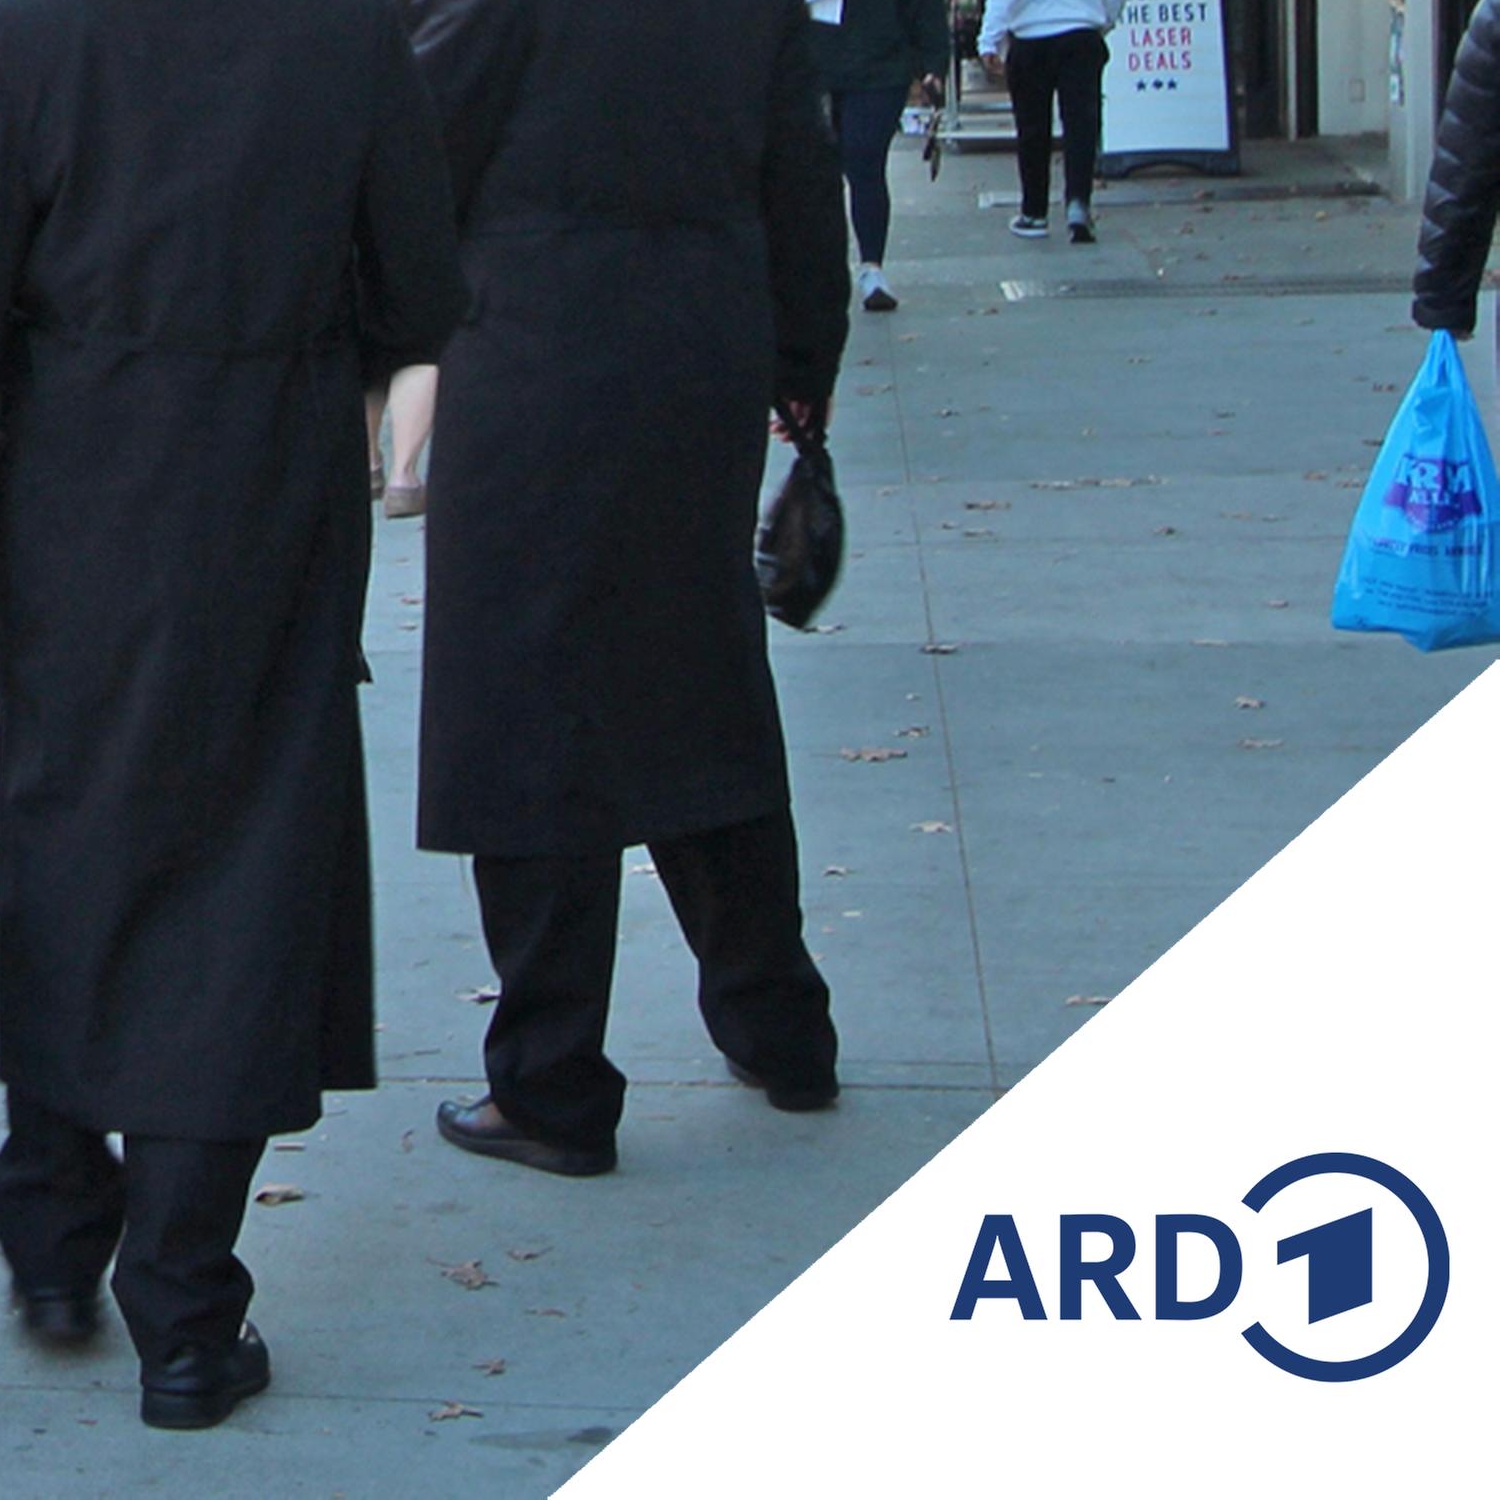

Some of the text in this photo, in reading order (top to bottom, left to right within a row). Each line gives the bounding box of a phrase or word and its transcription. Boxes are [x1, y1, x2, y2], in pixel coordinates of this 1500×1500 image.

[1158, 2, 1207, 22] BEST
[1131, 26, 1191, 47] LASER
[1128, 51, 1192, 72] DEALS
